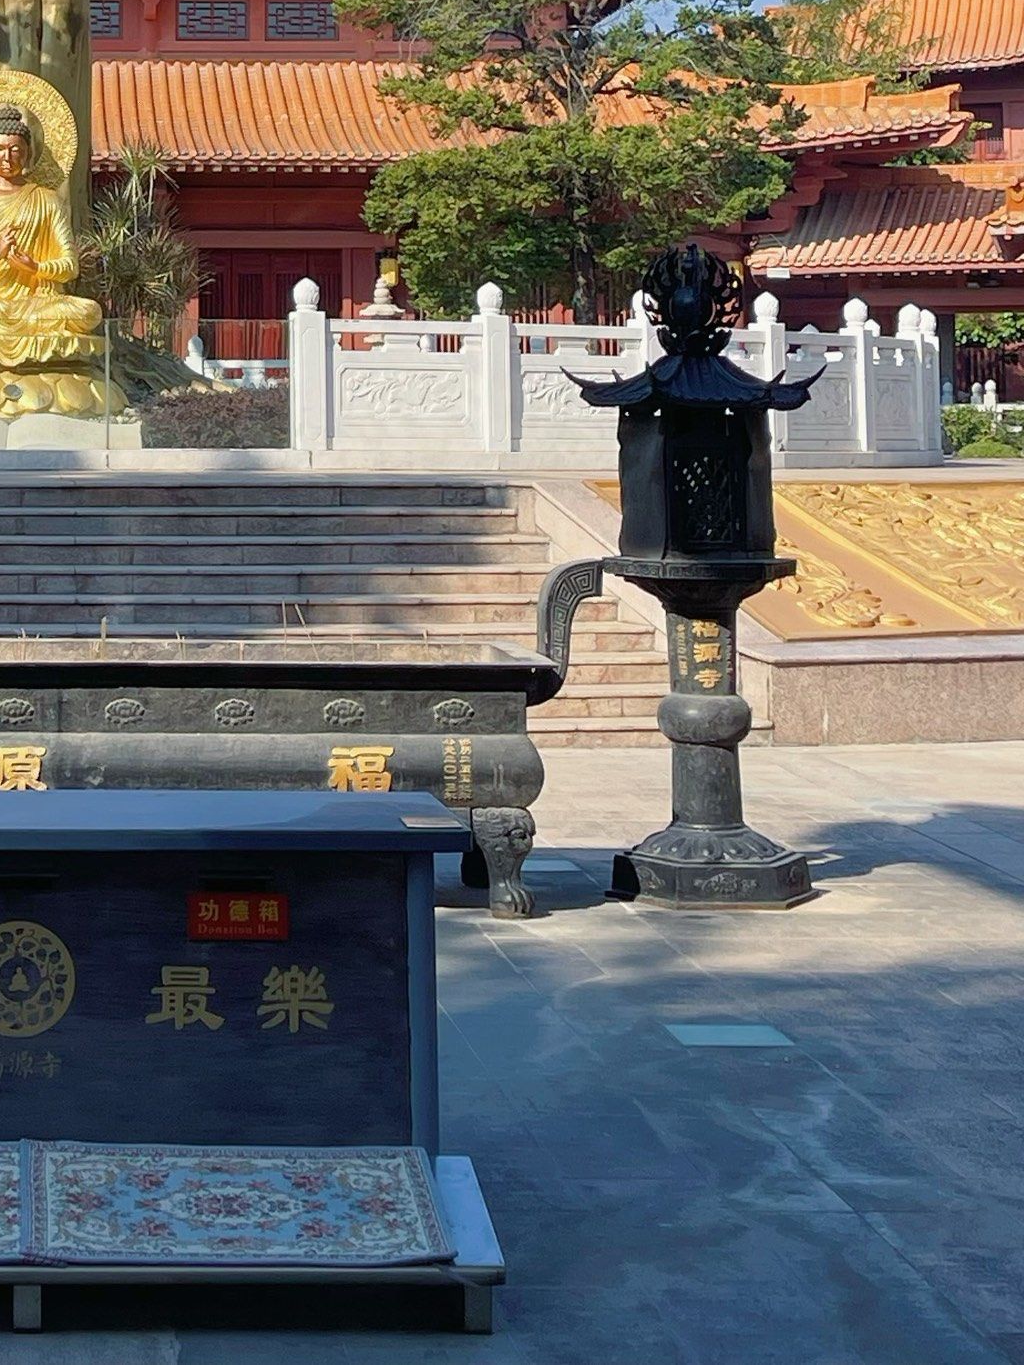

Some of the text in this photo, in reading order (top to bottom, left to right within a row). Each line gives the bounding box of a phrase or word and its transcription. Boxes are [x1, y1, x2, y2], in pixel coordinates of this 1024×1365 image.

[691, 619, 722, 688] 福源寺
[327, 746, 395, 793] 福
[197, 899, 279, 923] 功德箱
